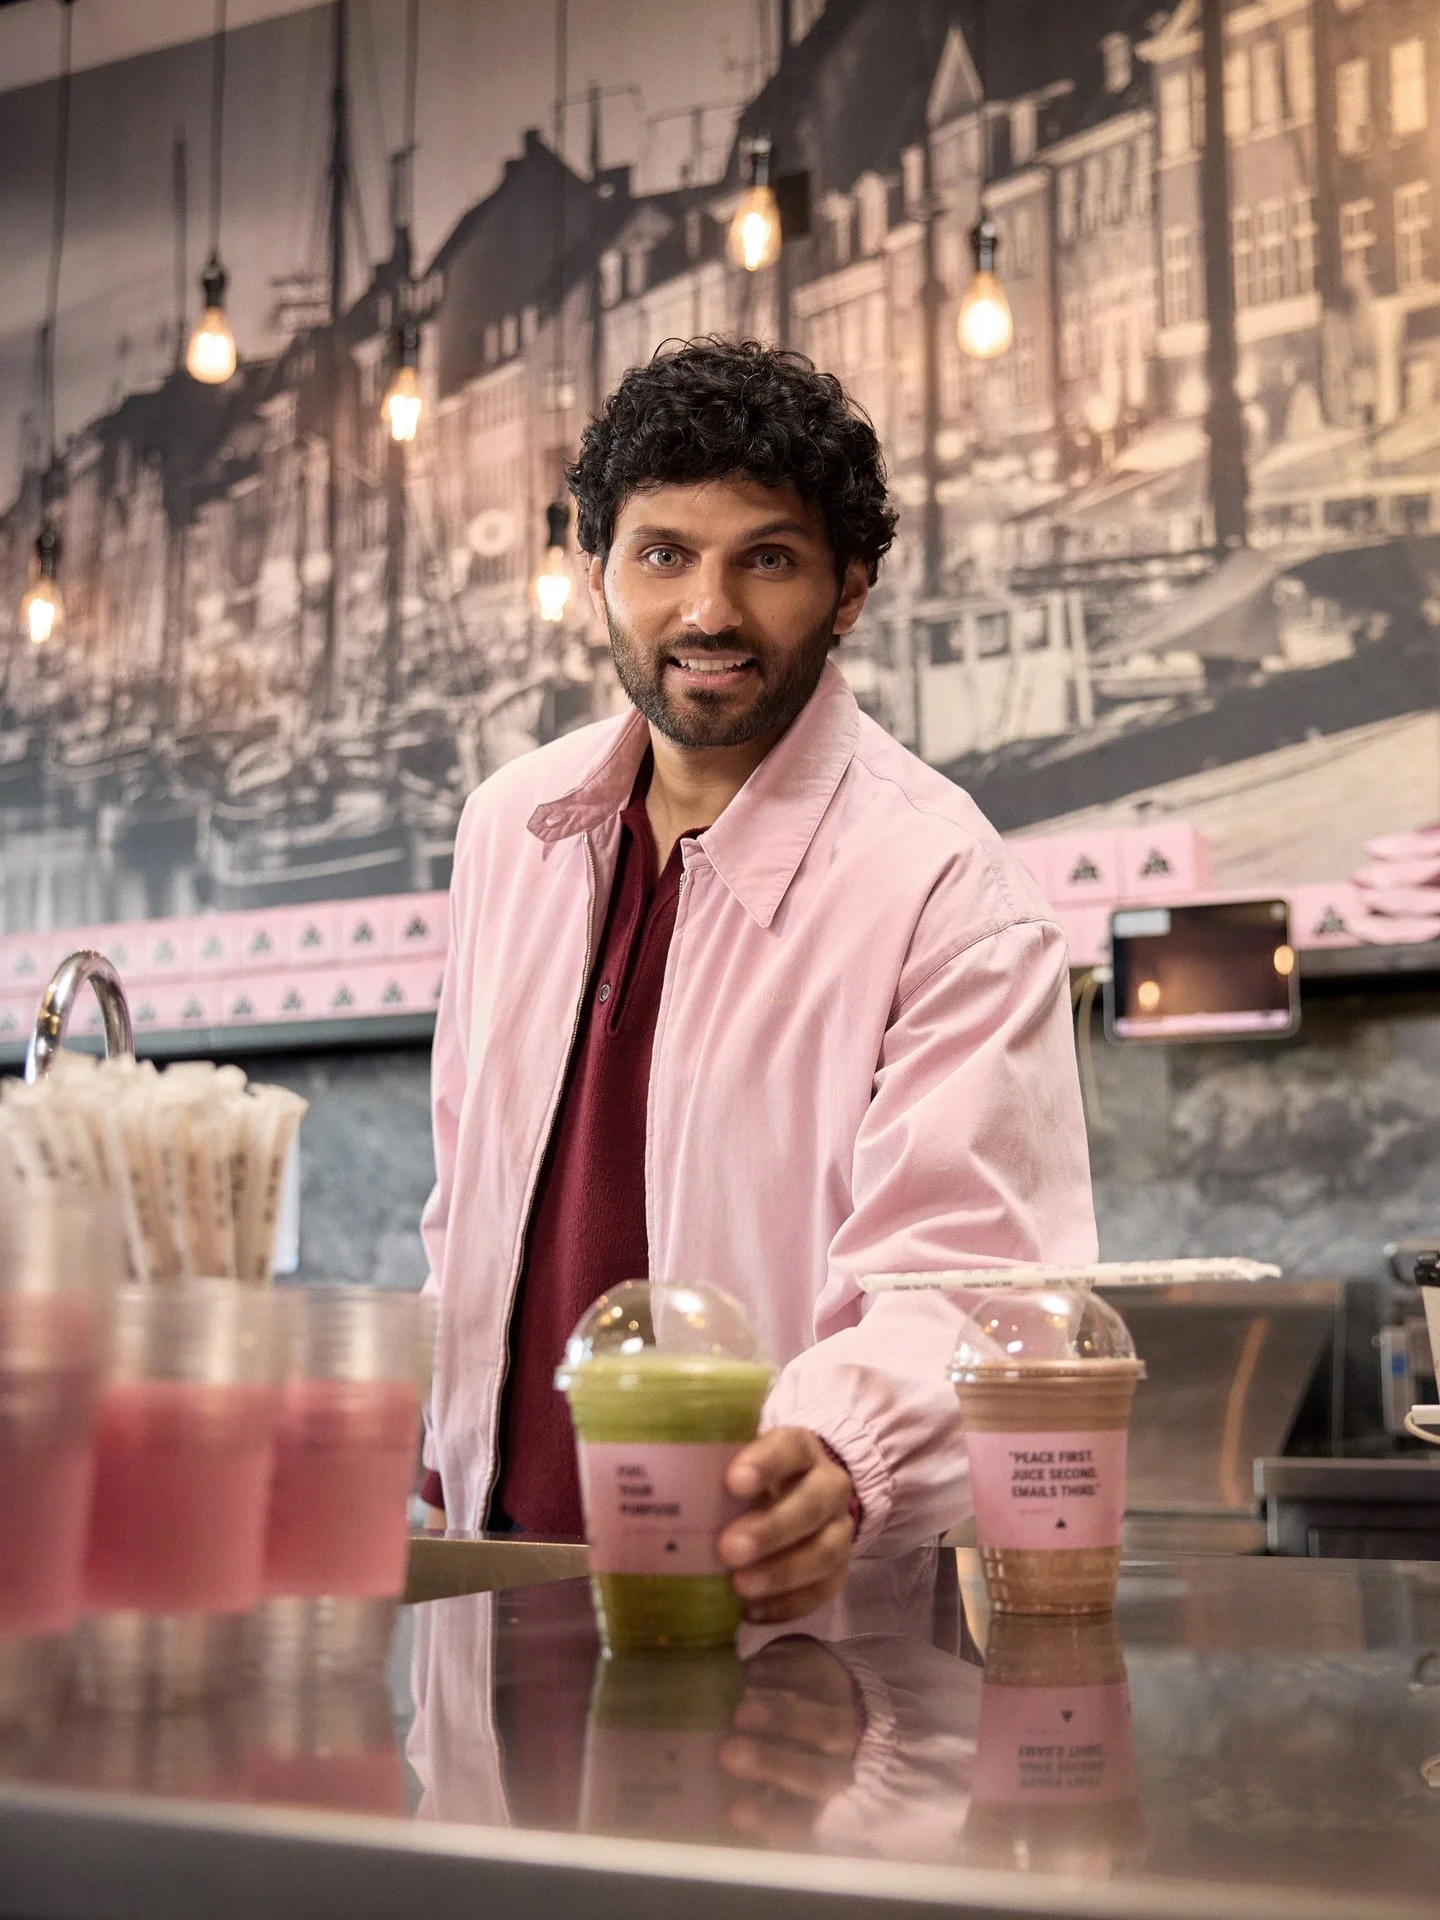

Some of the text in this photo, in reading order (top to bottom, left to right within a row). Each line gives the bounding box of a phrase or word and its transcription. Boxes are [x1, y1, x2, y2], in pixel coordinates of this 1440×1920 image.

[1008, 1450, 1054, 1464] "PEACE
[1012, 1467, 1044, 1480] JUICE
[1012, 1484, 1057, 1498] EMAILS
